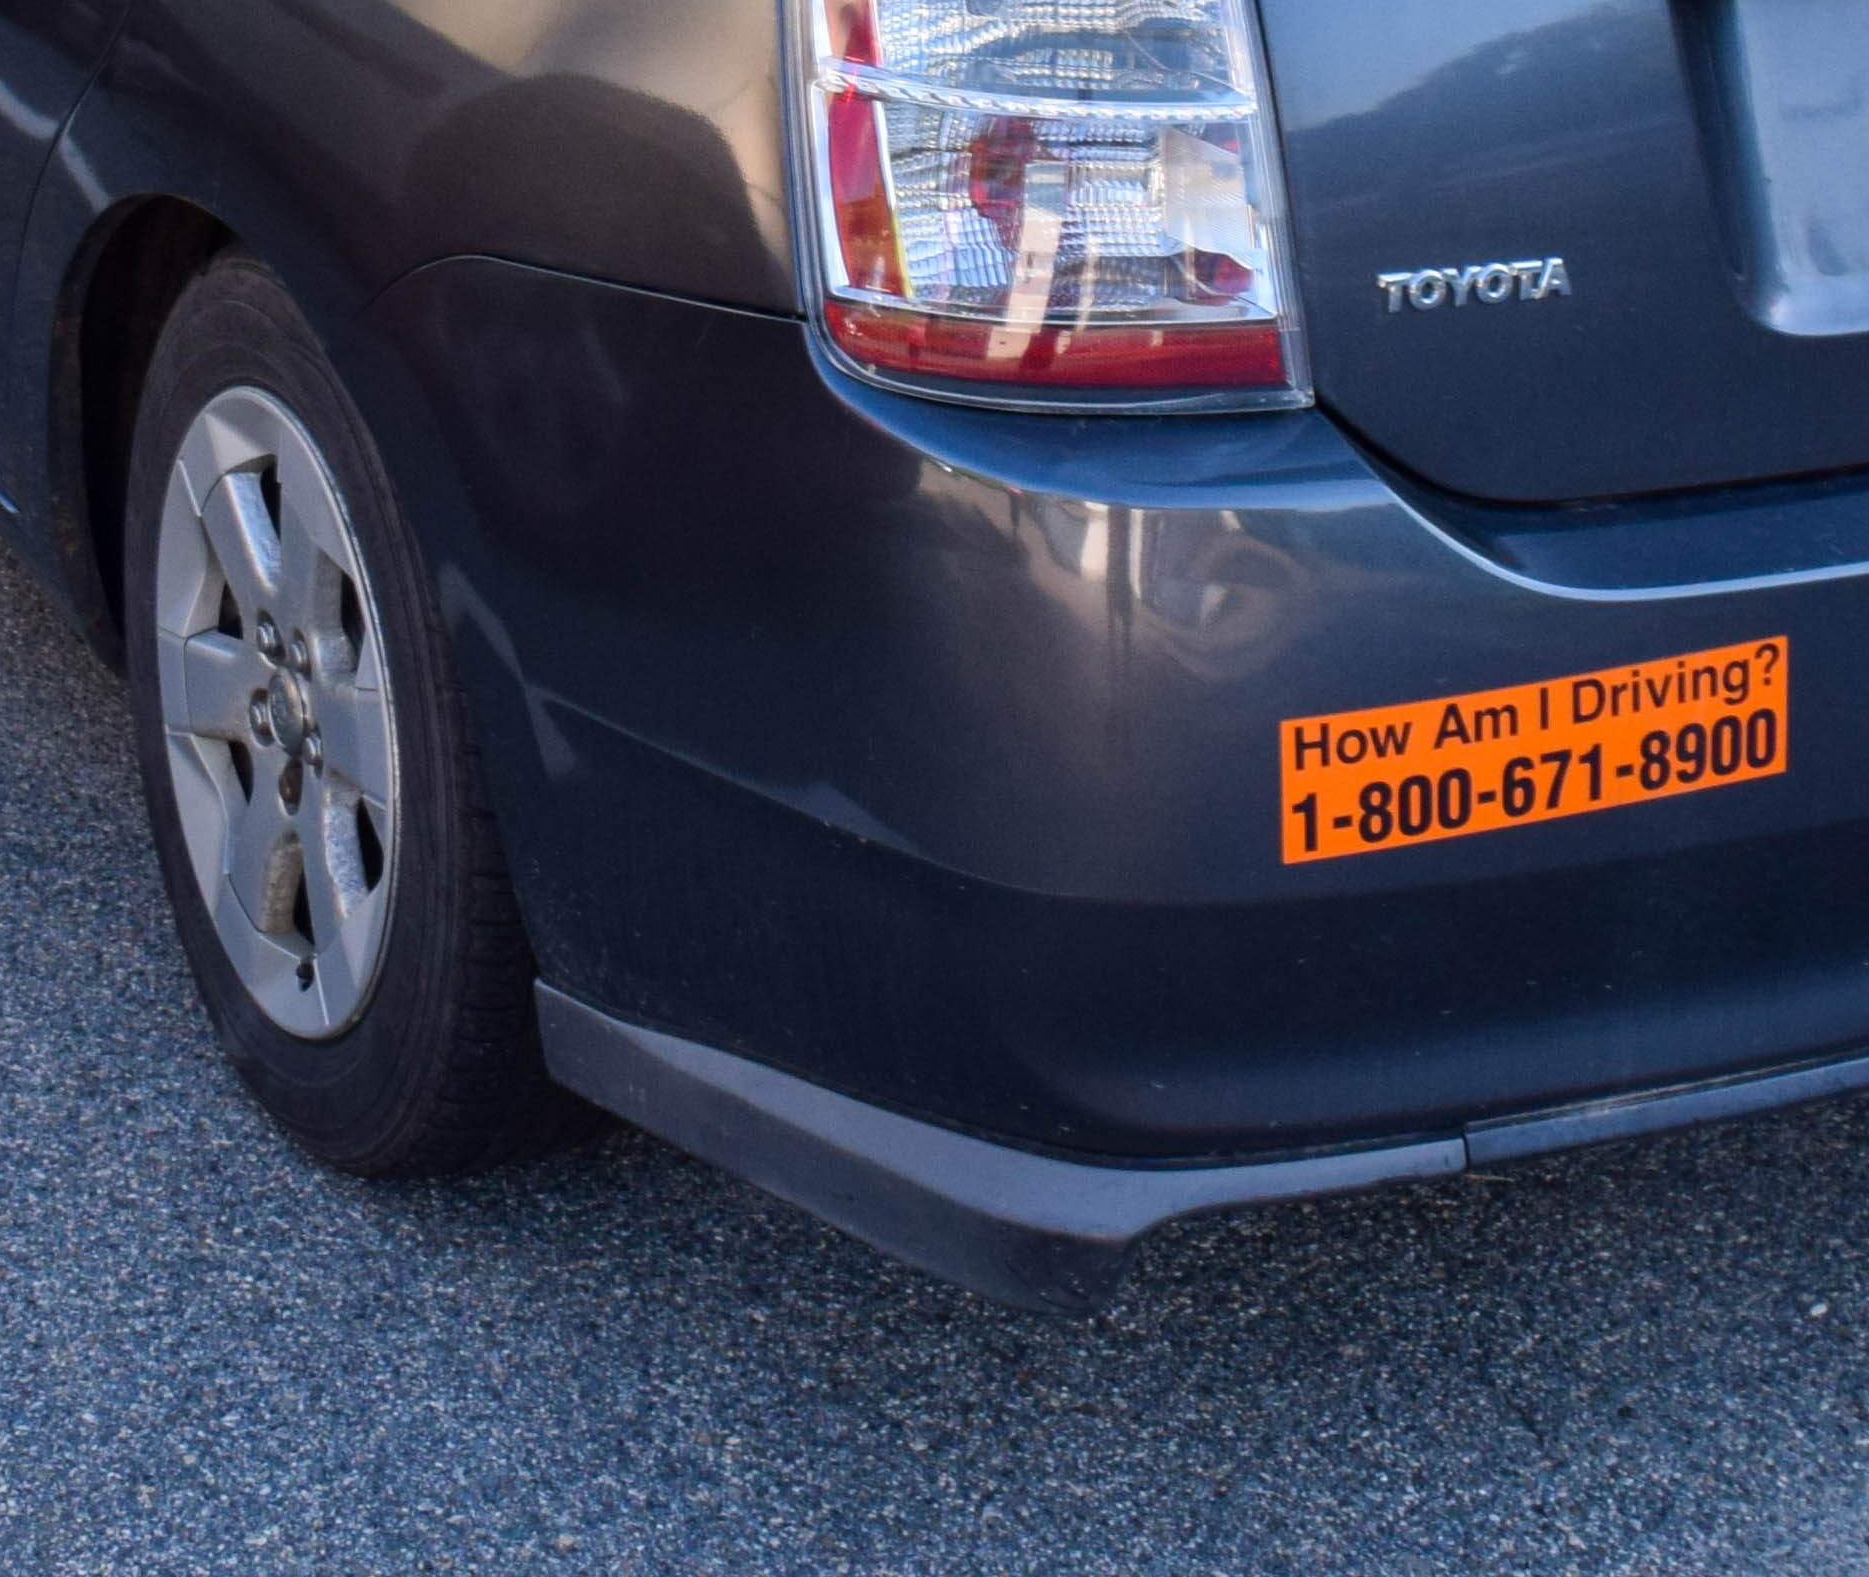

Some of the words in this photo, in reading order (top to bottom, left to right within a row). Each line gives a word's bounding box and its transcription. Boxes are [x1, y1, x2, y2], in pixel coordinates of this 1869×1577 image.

[1377, 257, 1572, 313] TOYOTA
[1293, 721, 1413, 771] How
[1434, 703, 1519, 749] Am
[1539, 686, 1550, 730] I
[1572, 642, 1781, 724] Driving?
[1290, 707, 1778, 853] 1-800-671-8900
